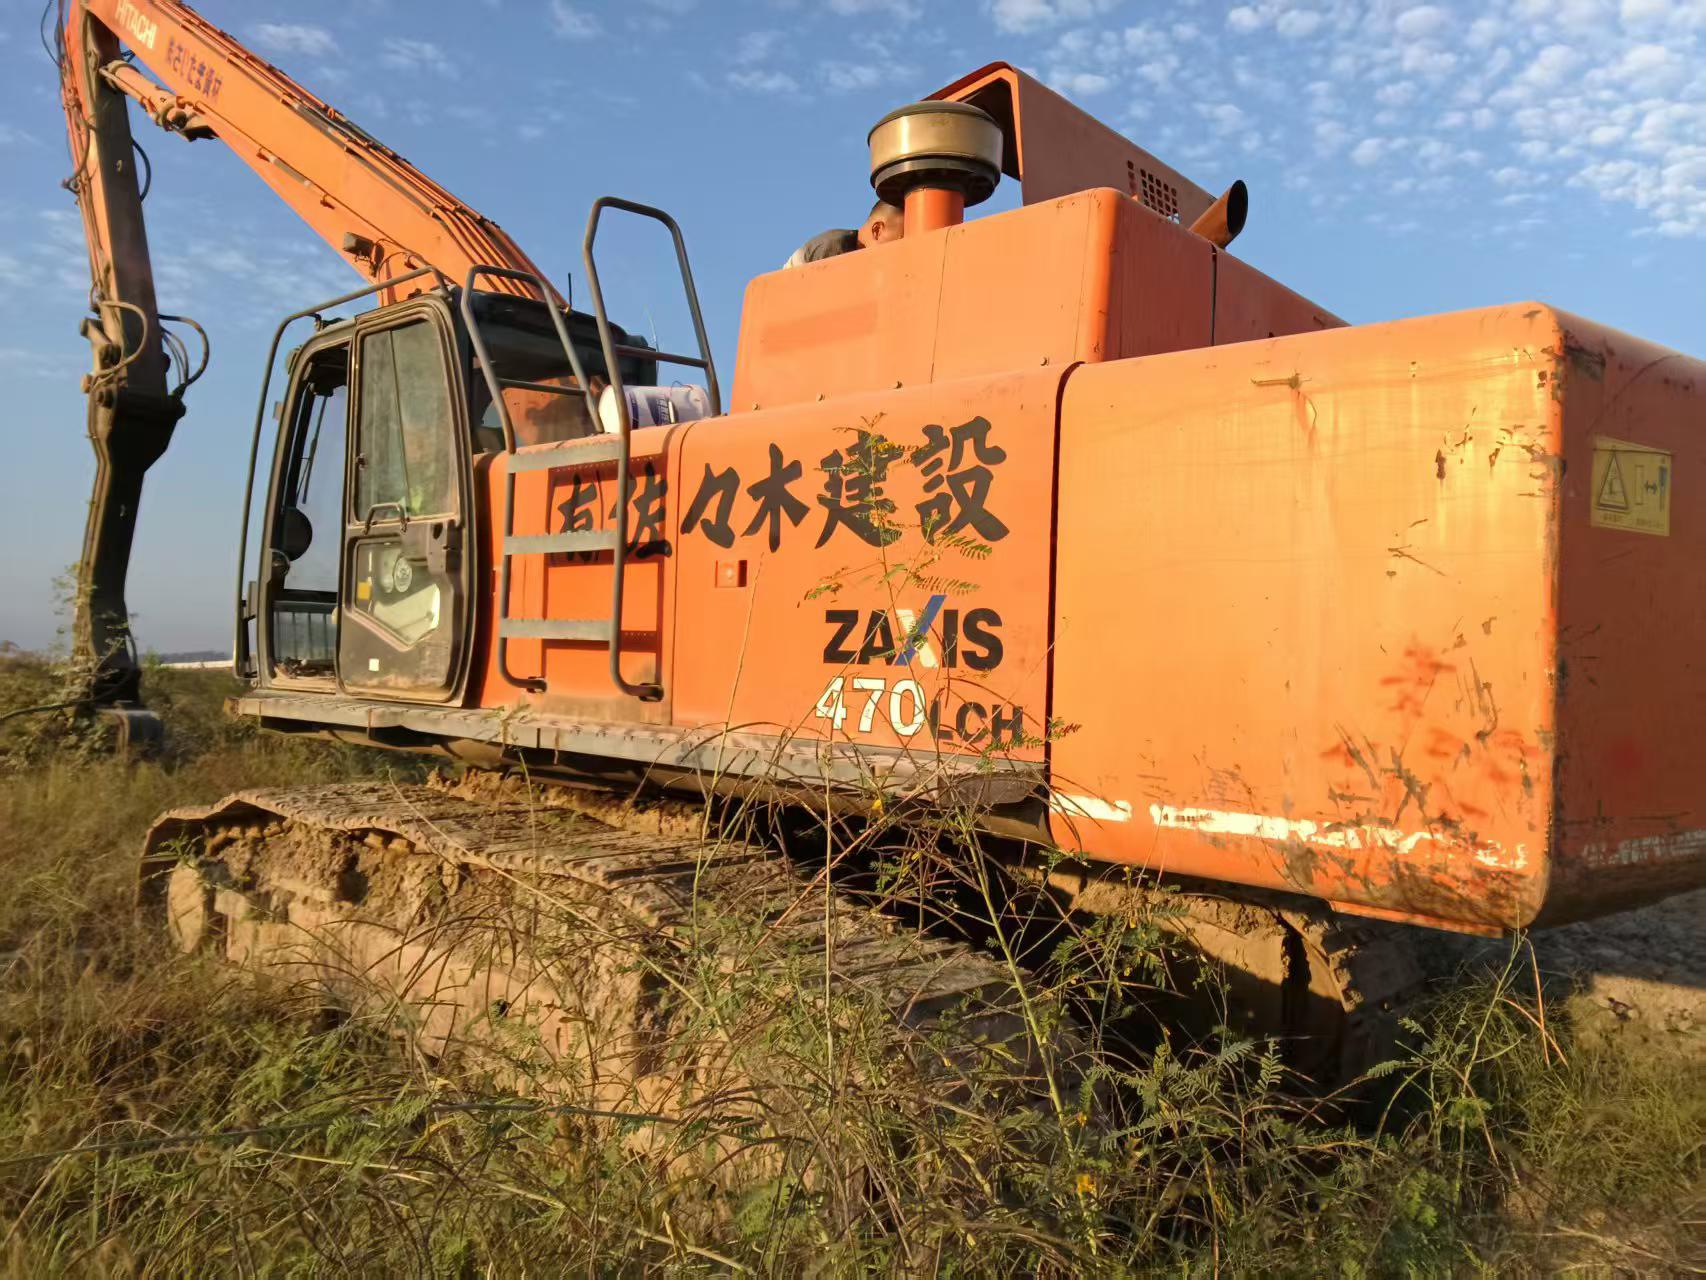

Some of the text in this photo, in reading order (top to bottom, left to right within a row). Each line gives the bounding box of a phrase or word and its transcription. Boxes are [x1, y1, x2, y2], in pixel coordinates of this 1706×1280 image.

[116, 1, 157, 49] HITACHI
[823, 594, 1004, 671] ZAXIS
[815, 676, 926, 736] 470
